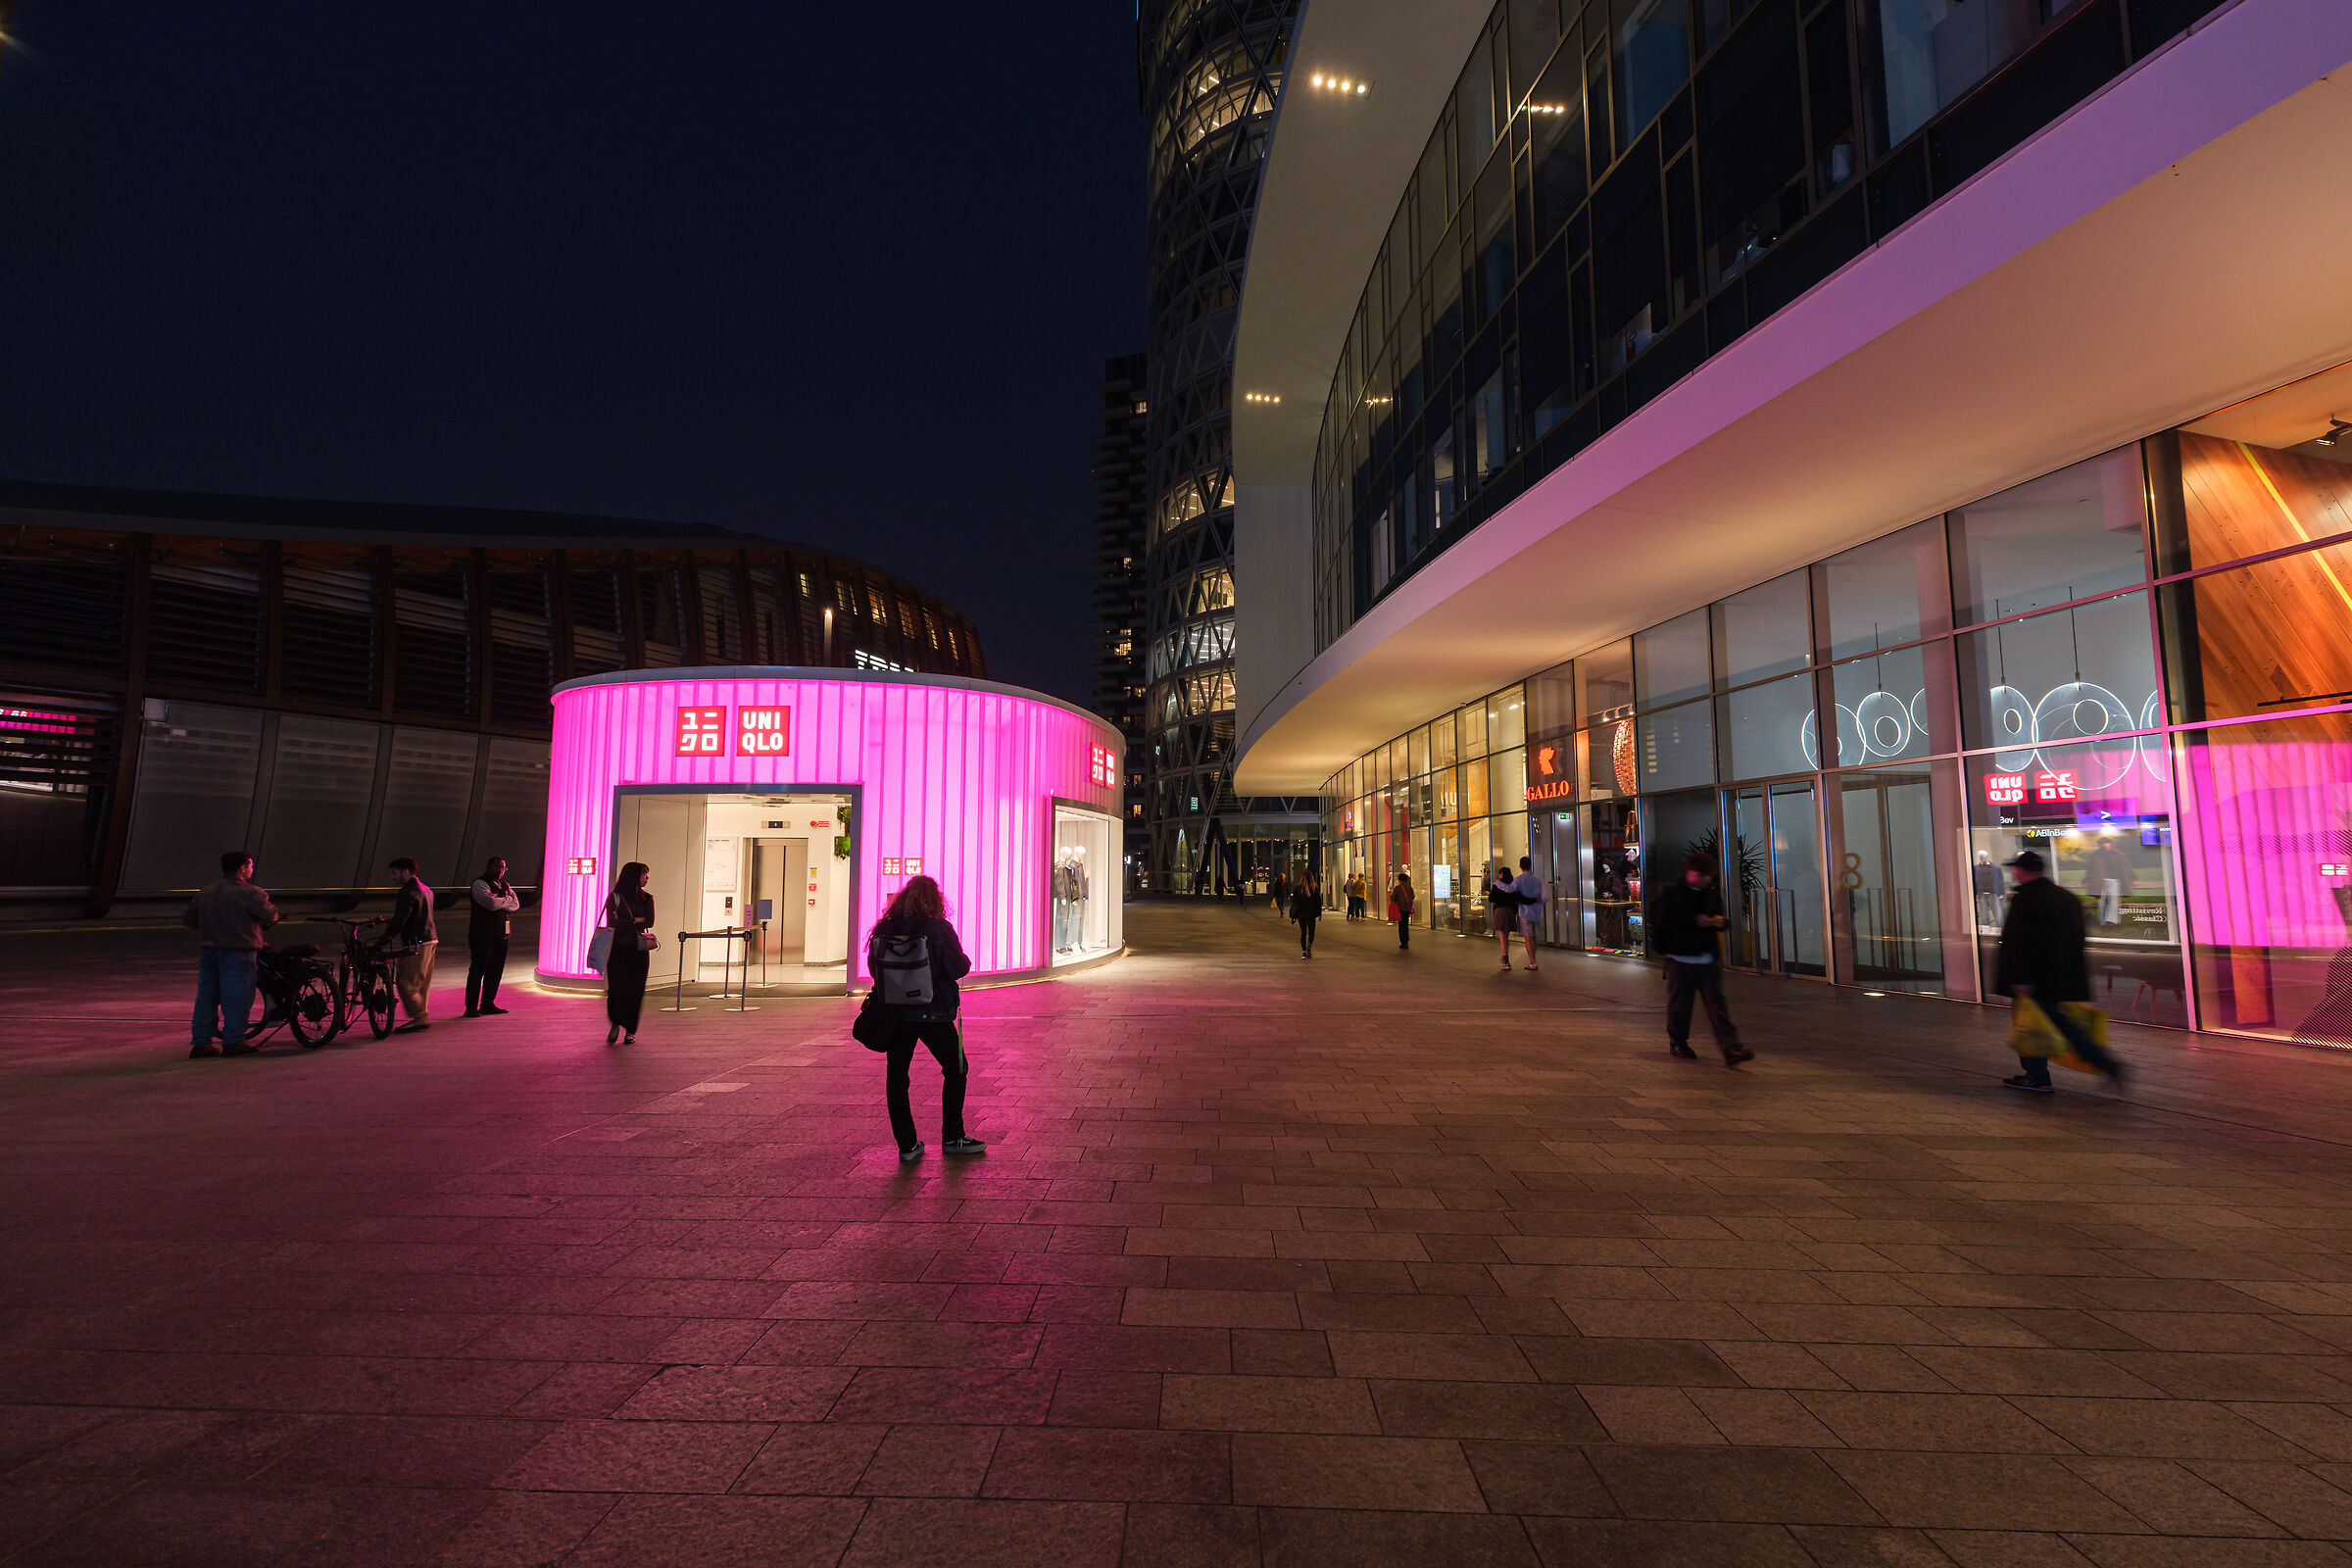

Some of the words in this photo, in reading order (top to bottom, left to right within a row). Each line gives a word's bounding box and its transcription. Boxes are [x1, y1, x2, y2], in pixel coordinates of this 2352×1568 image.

[682, 711, 719, 730] ユニ
[743, 711, 781, 730] UNI
[679, 733, 718, 752] クロ
[742, 732, 784, 754] QLO
[1527, 780, 1570, 802] GALLO
[1842, 853, 1862, 889] 8
